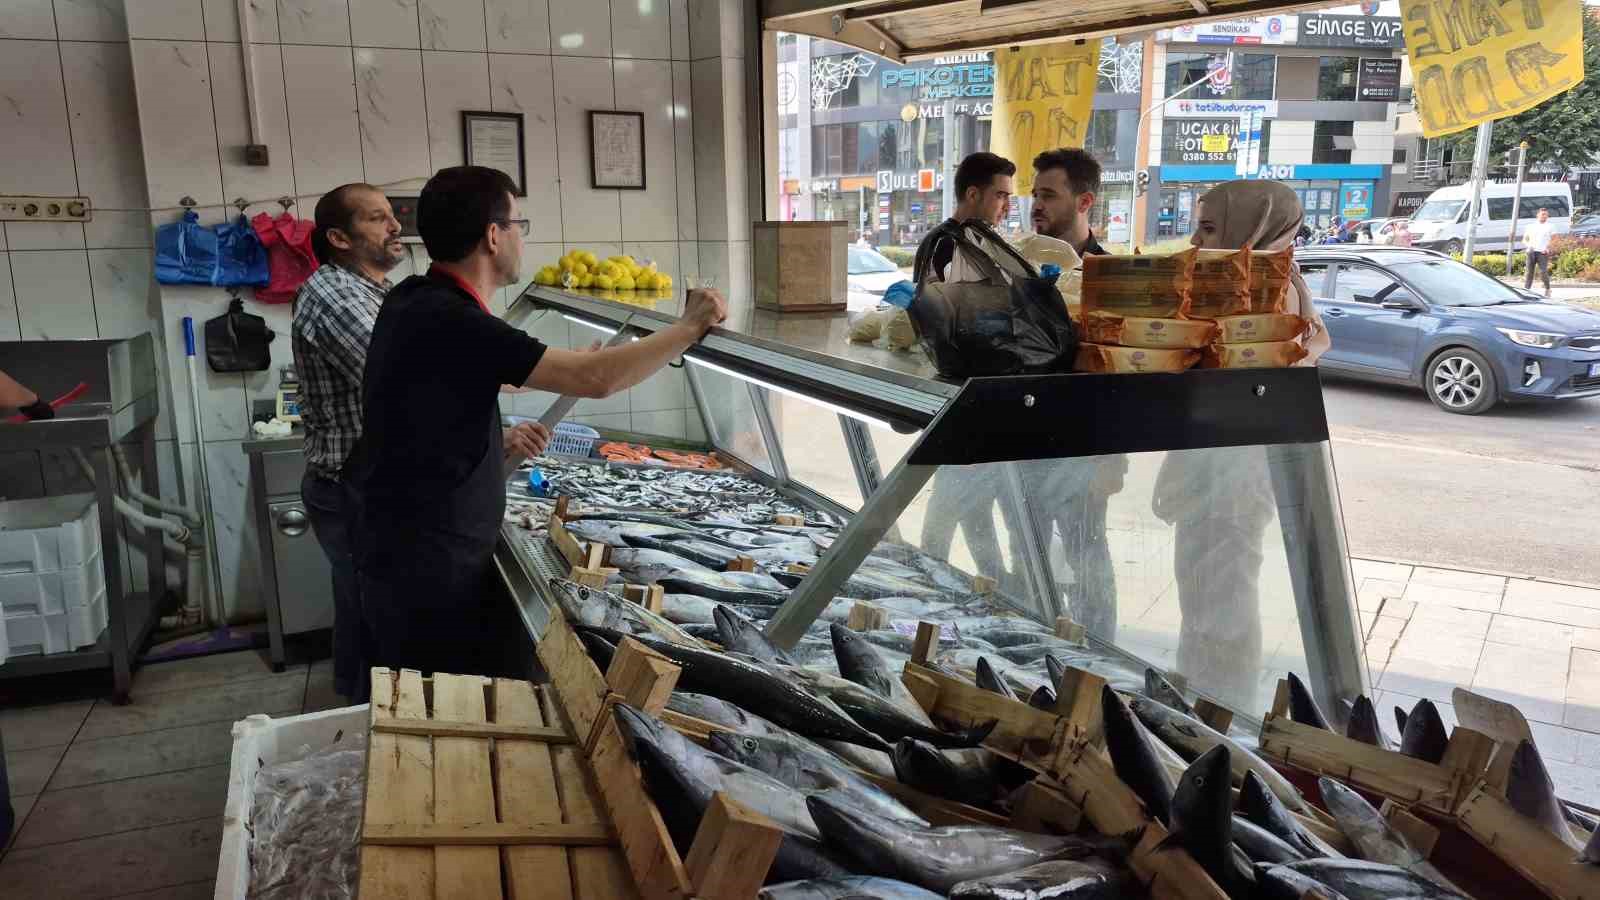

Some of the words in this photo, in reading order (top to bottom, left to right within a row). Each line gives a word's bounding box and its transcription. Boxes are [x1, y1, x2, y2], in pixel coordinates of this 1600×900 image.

[1371, 20, 1405, 38] YAP
[1183, 152, 1205, 161] 0380
[1208, 152, 1224, 161] 552
